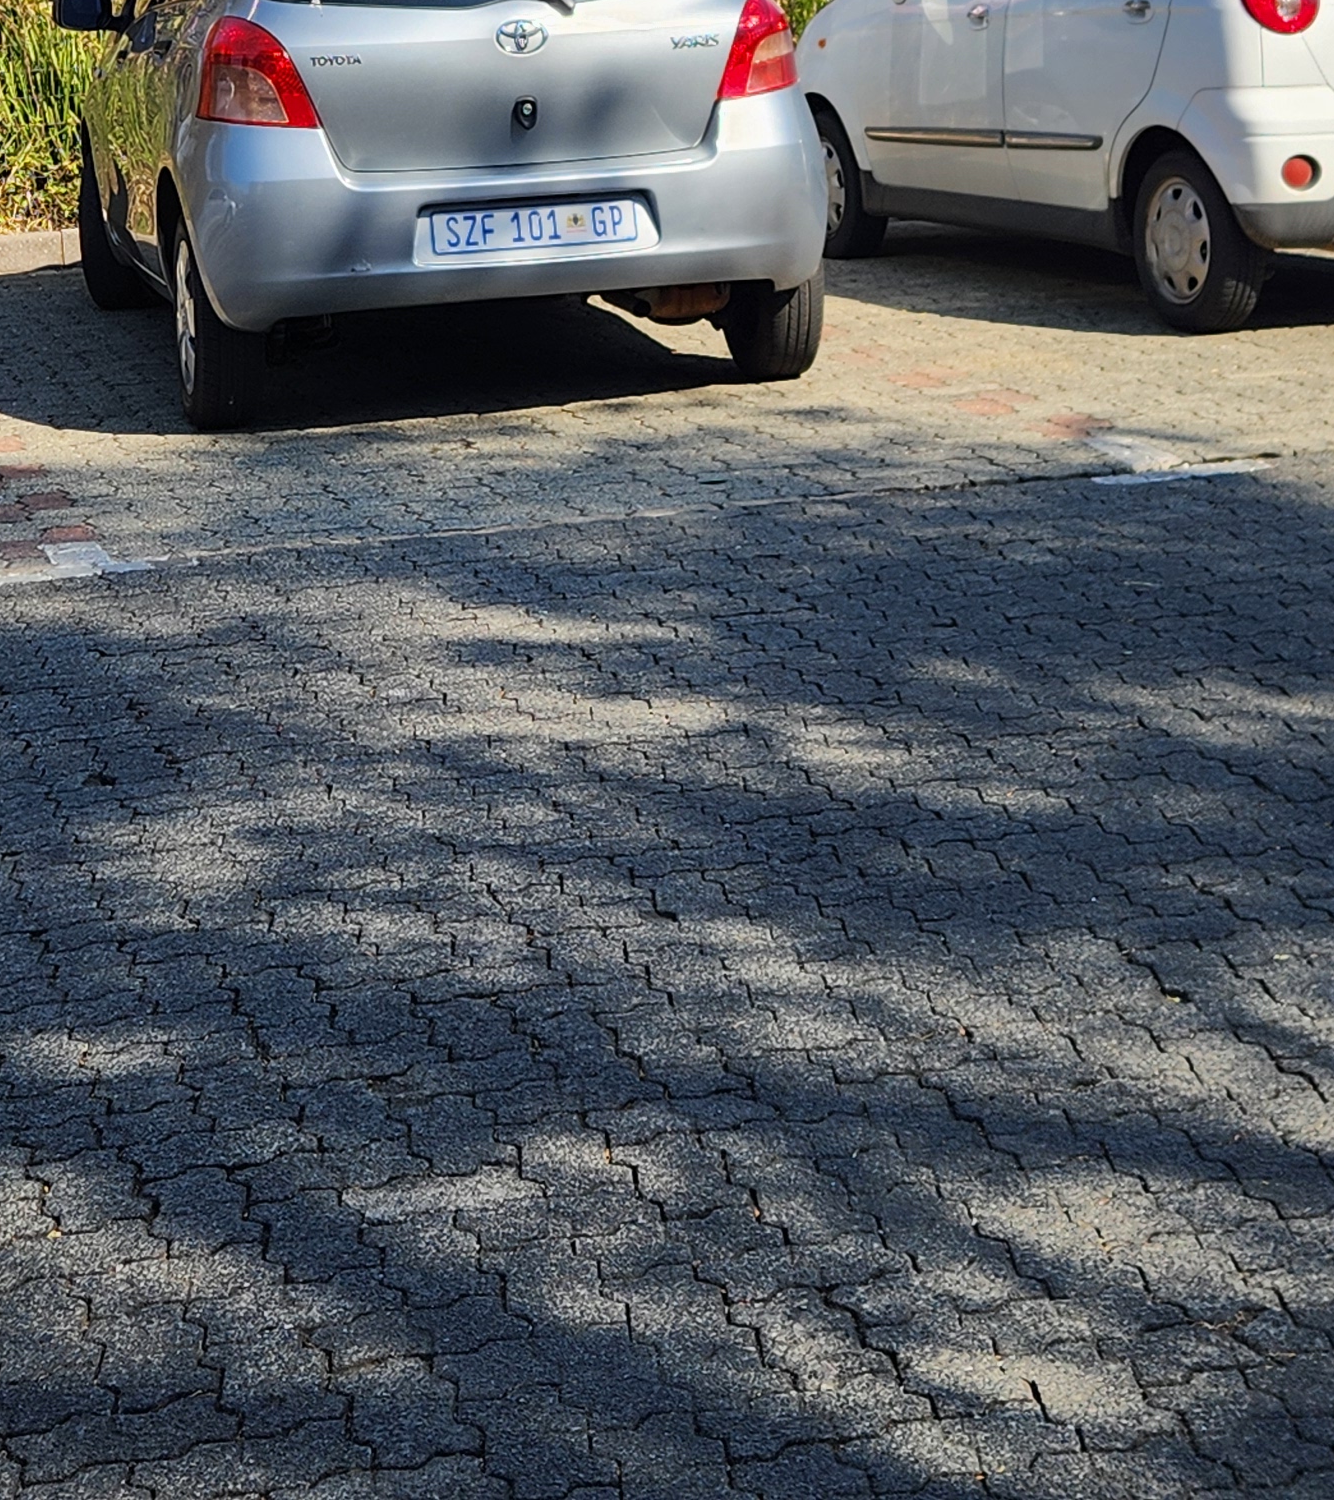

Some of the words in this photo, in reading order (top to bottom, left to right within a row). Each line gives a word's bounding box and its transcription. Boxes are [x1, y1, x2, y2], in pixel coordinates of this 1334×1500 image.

[669, 33, 720, 50] YARIS
[310, 54, 362, 67] TOYOTA
[446, 214, 495, 248] SZF
[511, 209, 562, 243] 101
[592, 204, 624, 238] GP
